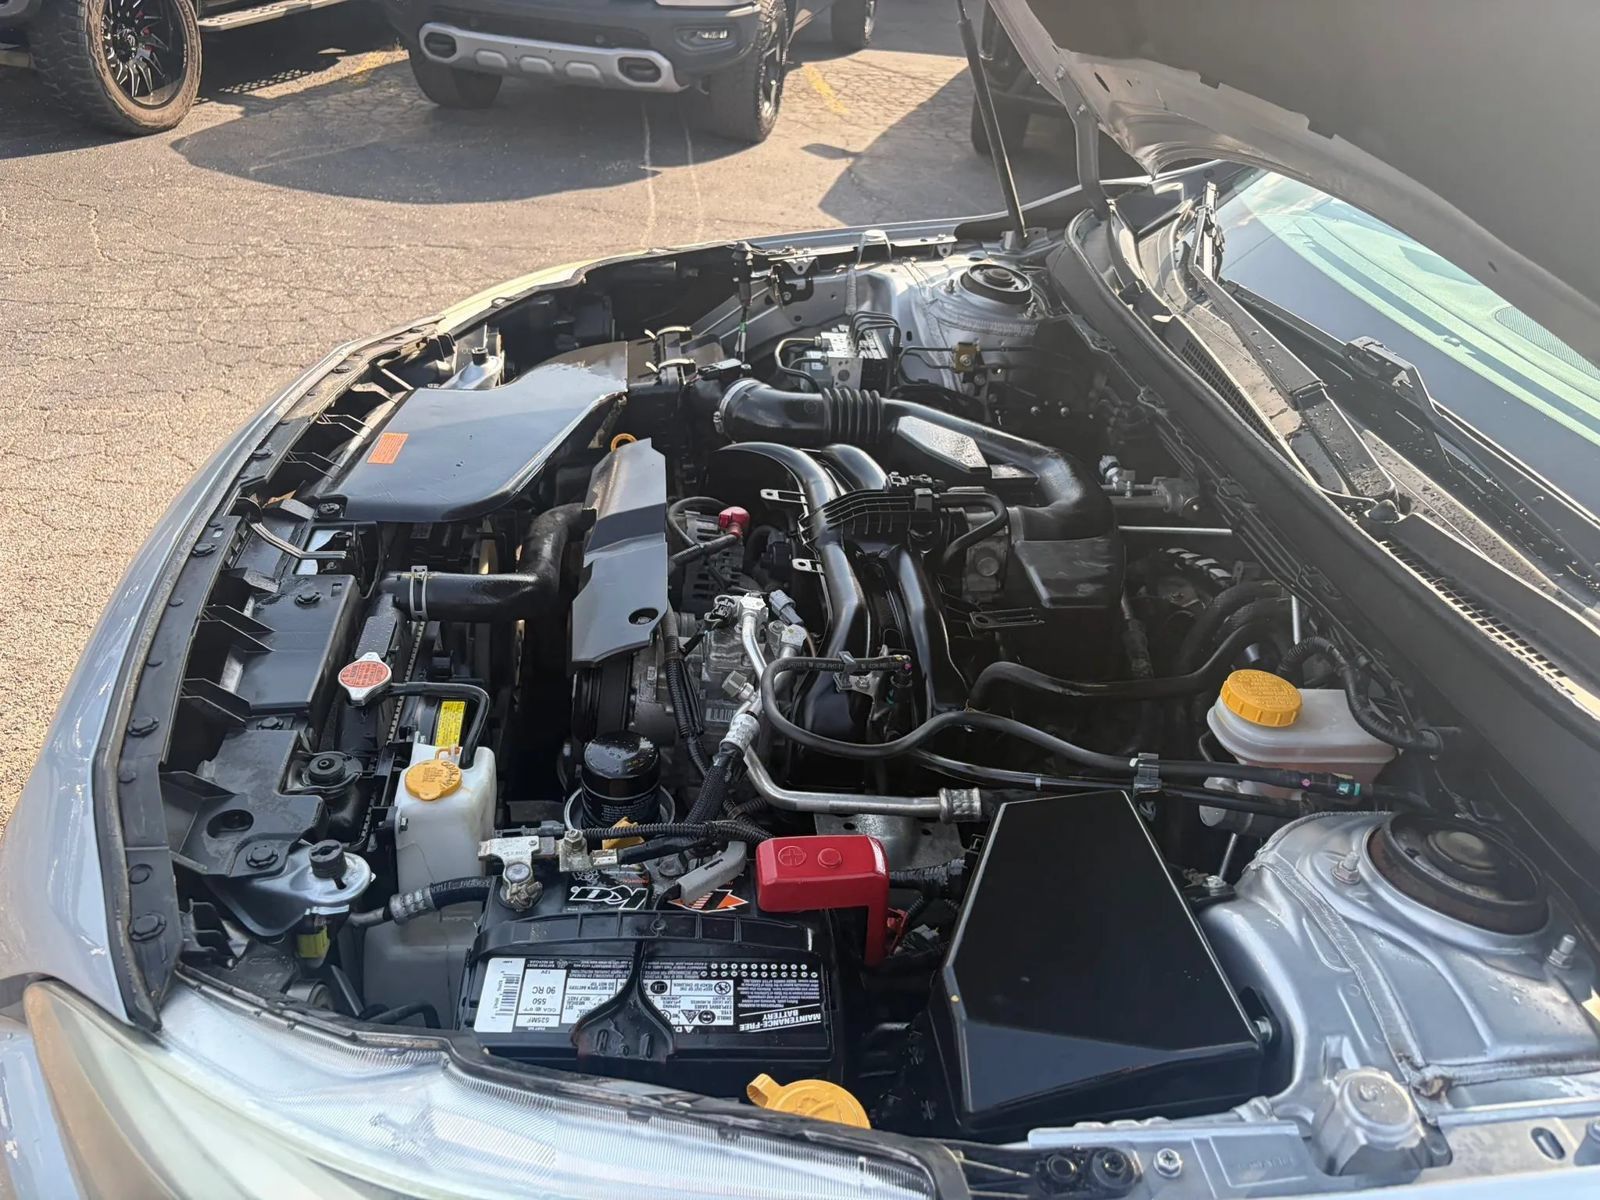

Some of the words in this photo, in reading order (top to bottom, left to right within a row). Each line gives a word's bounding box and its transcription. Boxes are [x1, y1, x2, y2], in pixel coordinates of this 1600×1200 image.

[532, 986, 544, 994] RC
[762, 1010, 799, 1020] BATTERY
[739, 1013, 821, 1031] MAINTENANCE-FREE
